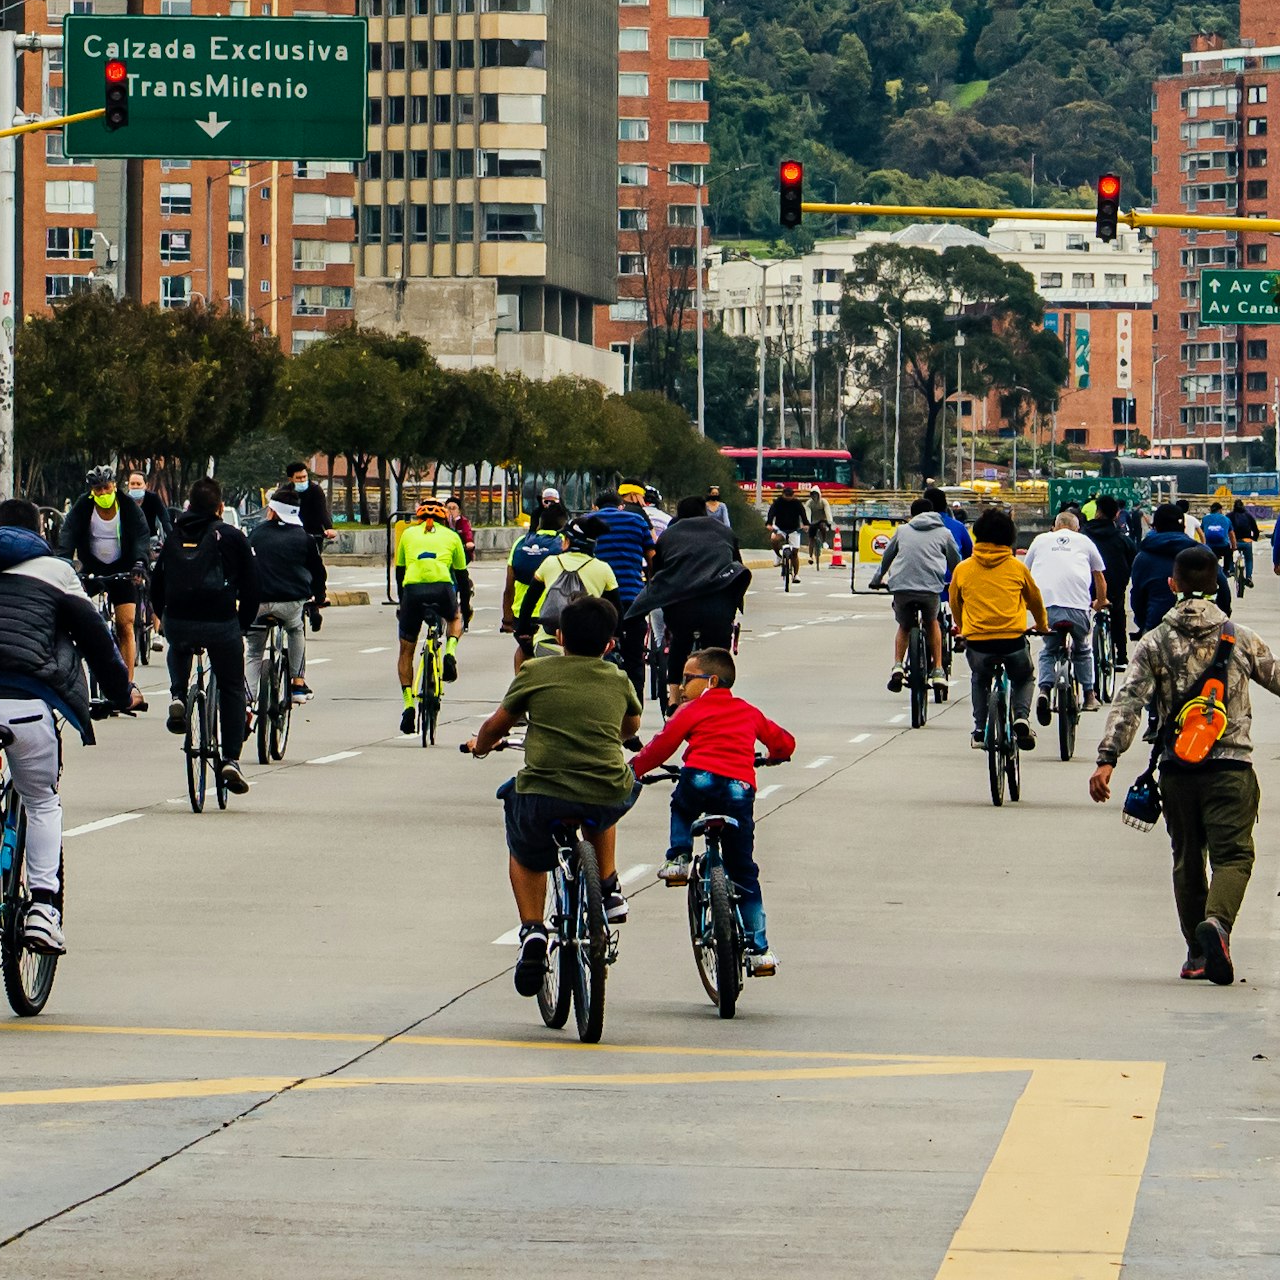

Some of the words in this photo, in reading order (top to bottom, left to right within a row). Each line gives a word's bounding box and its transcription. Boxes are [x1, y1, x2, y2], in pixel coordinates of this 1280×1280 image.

[83, 34, 196, 59] Calzada
[210, 36, 349, 61] Exclusiva
[126, 73, 308, 99] TransMilenio
[1230, 280, 1251, 293] Av
[1209, 301, 1230, 313] Av
